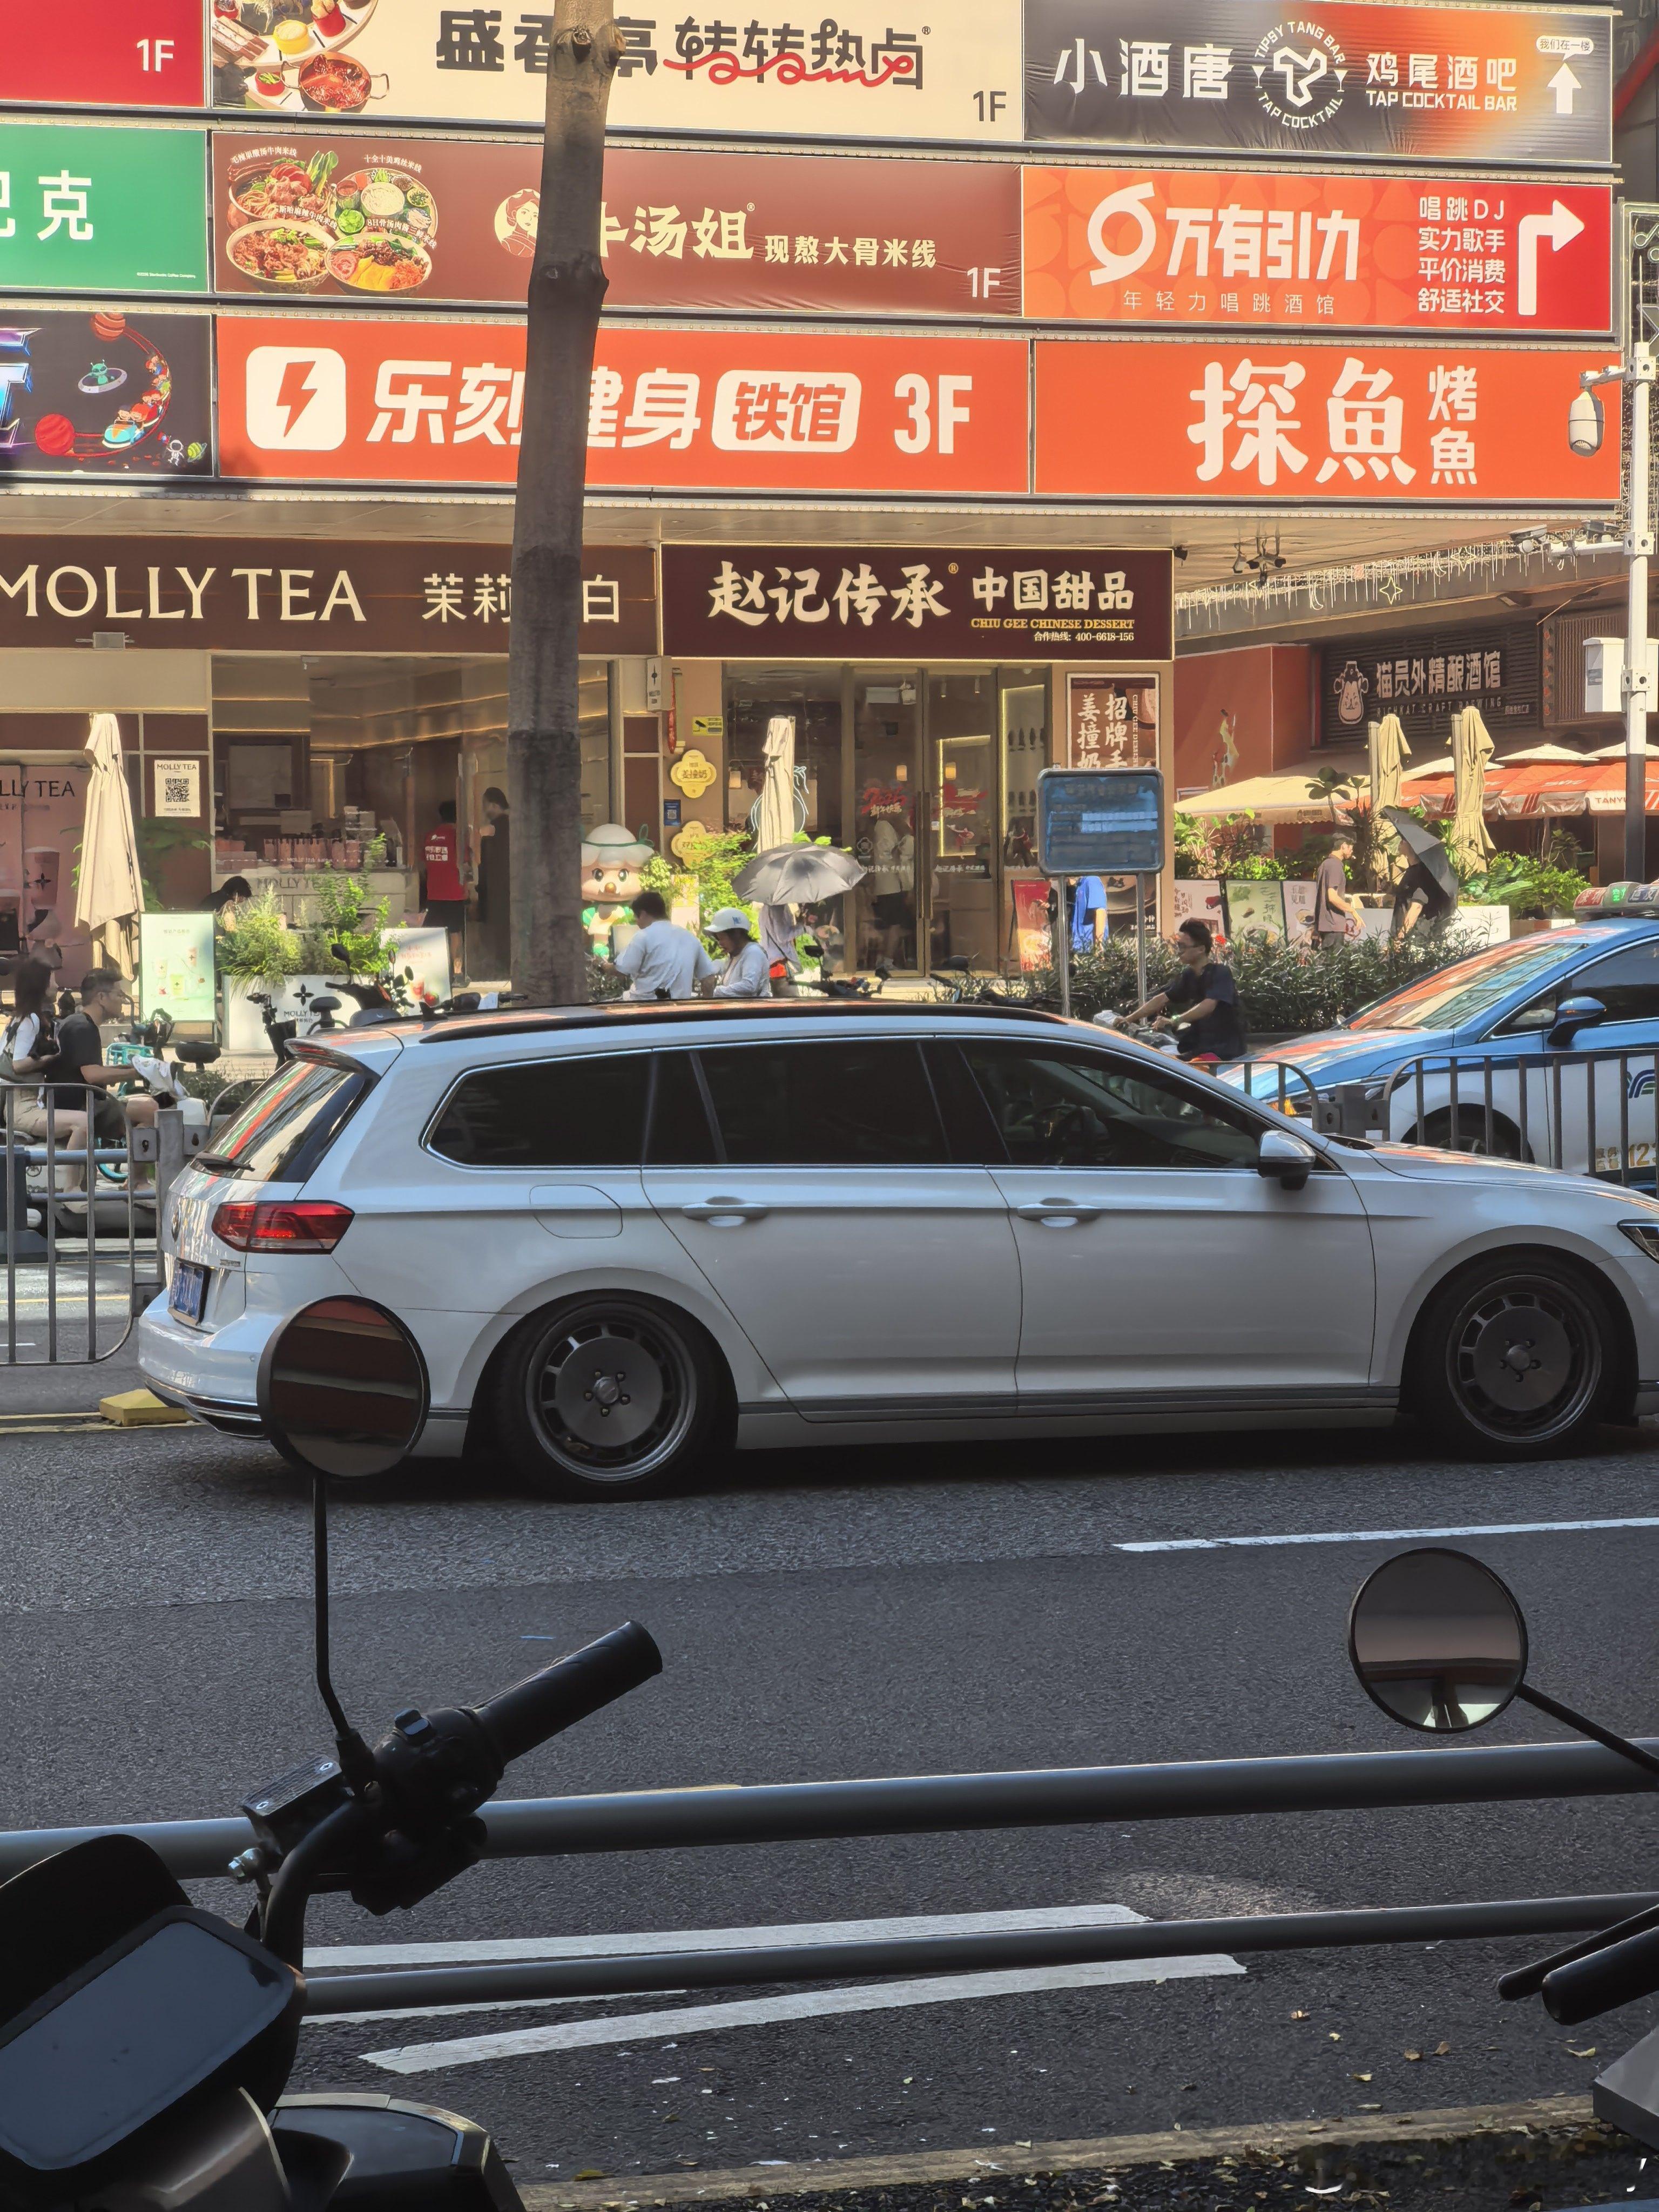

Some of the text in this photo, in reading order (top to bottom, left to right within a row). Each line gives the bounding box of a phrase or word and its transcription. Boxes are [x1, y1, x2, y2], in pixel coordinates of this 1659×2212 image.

[137, 38, 174, 72] 1F
[1255, 21, 1346, 64] TIPSY TANG BAR
[1540, 39, 1590, 51] 我们在一楼
[1054, 38, 1235, 99] 小酒唐
[1366, 52, 1518, 92] 鸡尾酒吧
[973, 90, 1007, 122] 1F
[1257, 92, 1343, 129] TAP COCKTAIL
[1366, 90, 1518, 112] TAP COCKTAIL BAR
[0, 169, 93, 241] 克
[765, 235, 937, 267] 现熬大骨米线
[1165, 204, 1360, 280] 万有引力
[1418, 226, 1506, 253] 实力歌手
[967, 267, 1001, 298] 1F
[1418, 257, 1506, 284] 平价消费
[1123, 289, 1335, 314] 年轻力唱跳酒馆
[1418, 288, 1505, 314] 舒适社交
[732, 381, 846, 442] 铁馆
[894, 373, 973, 454] 3F
[0, 564, 367, 621] MOLLY TEA
[422, 572, 619, 623] 茉莉白
[707, 561, 952, 628] 赵记传承
[972, 566, 1134, 612] 中国甜品
[971, 618, 1135, 629] CHIU GEE CHINESE DESSERT
[1376, 650, 1501, 699] 猫员外精酿酒馆
[35, 781, 75, 797] TEA
[1629, 1142, 1656, 1167] 12
